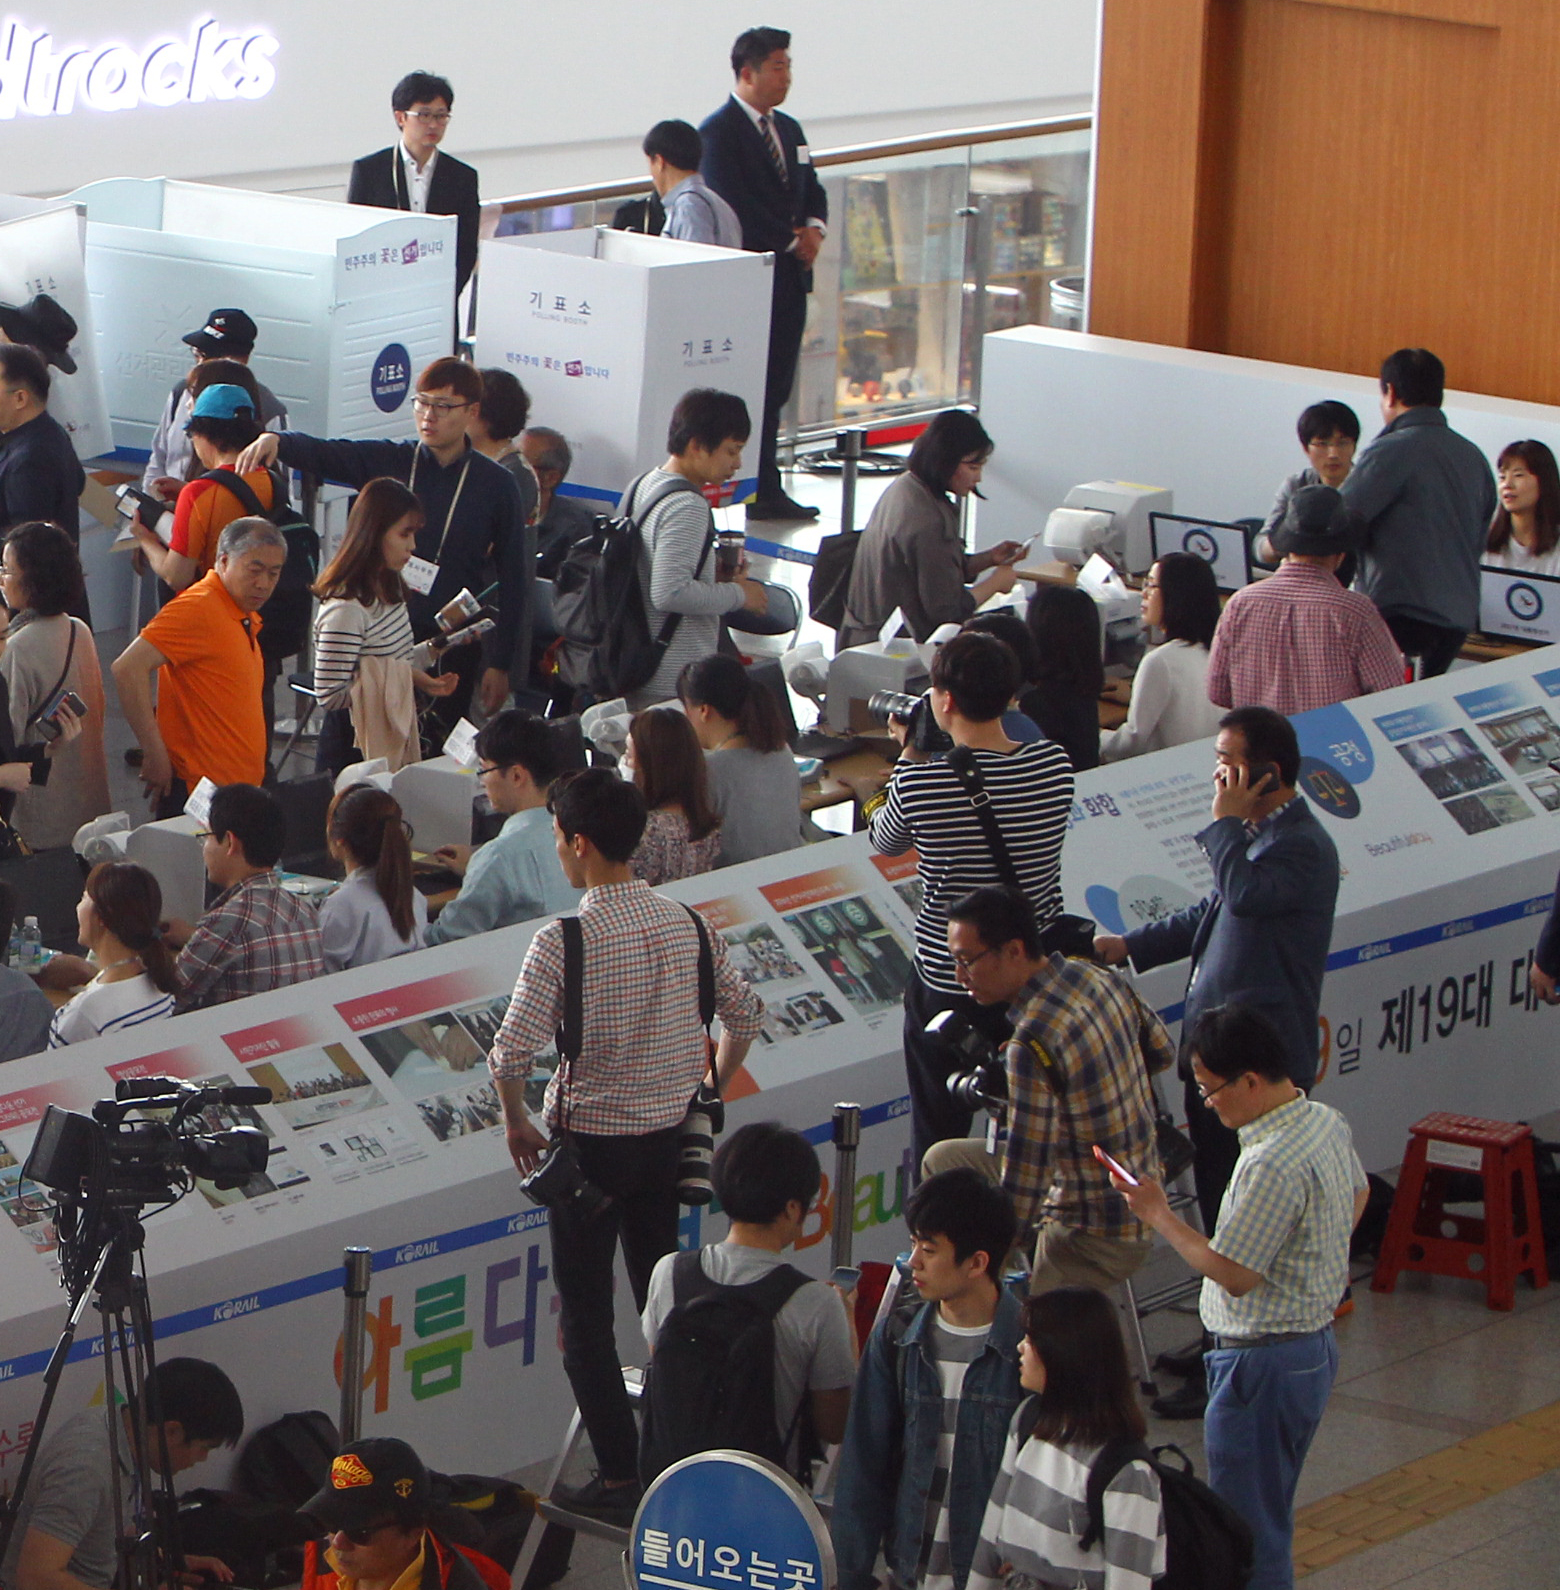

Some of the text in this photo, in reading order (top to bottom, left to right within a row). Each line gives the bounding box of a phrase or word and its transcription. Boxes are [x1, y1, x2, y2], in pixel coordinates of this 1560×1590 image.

[379, 363, 405, 383] 기표소
[1328, 740, 1366, 767] 공정
[1082, 792, 1121, 818] 화합
[1378, 960, 1494, 1054] 제19대
[395, 1240, 439, 1264] KORAIL
[213, 1296, 260, 1321] KORAIL
[333, 1245, 562, 1414] 아름다
[641, 1528, 816, 1590] 들어오는곳
